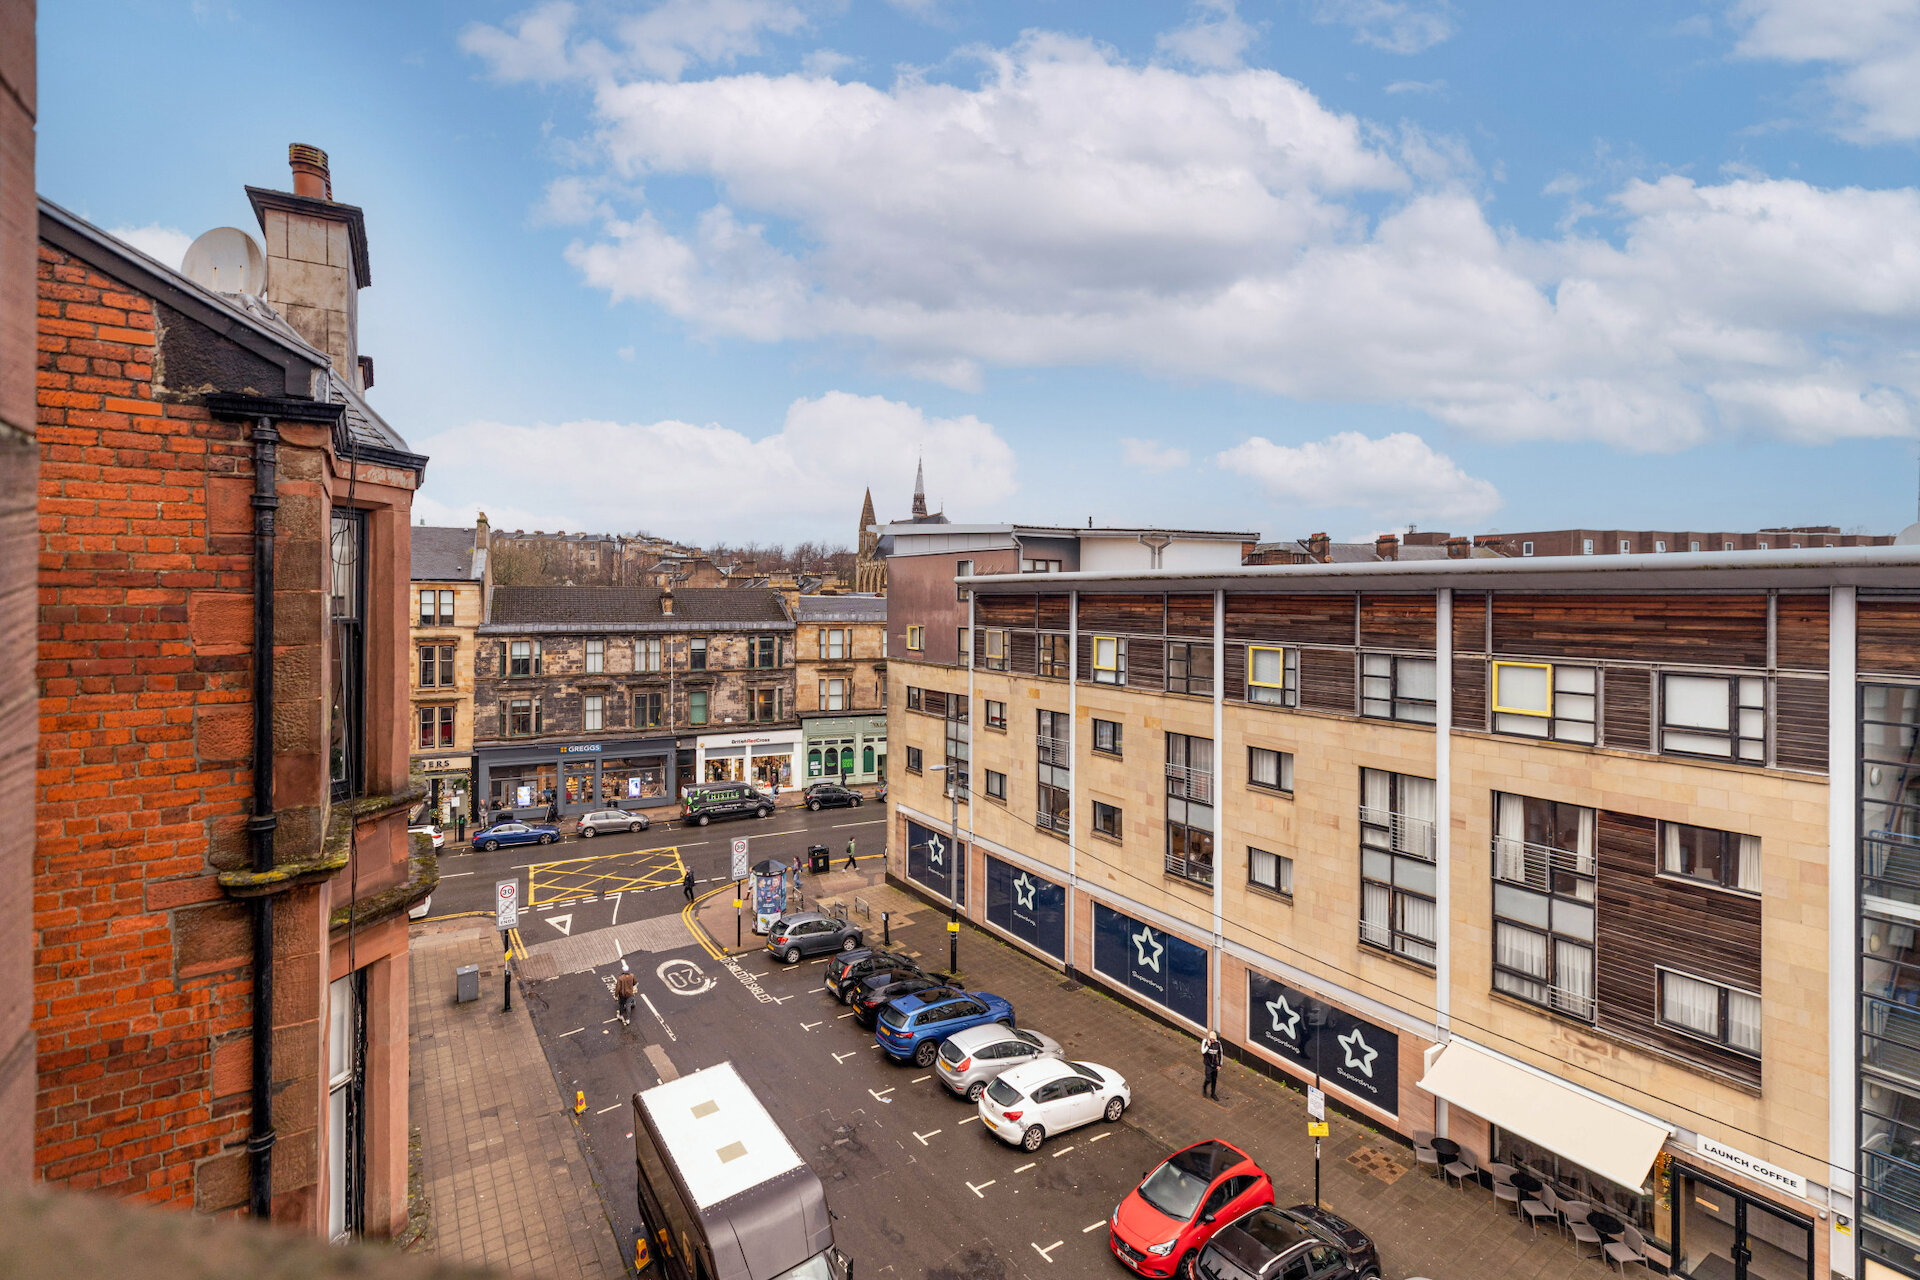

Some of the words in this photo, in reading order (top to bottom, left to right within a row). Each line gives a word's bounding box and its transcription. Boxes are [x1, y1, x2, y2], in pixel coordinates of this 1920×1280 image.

[568, 744, 600, 752] GREGGS
[706, 791, 740, 801] THISTLE
[1132, 970, 1164, 992] Superdrug
[1265, 1031, 1300, 1054] Superdrug
[1337, 1067, 1378, 1093] Superdrug
[1704, 1144, 1749, 1167] LAUNCH
[1753, 1165, 1797, 1188] COFFEE
